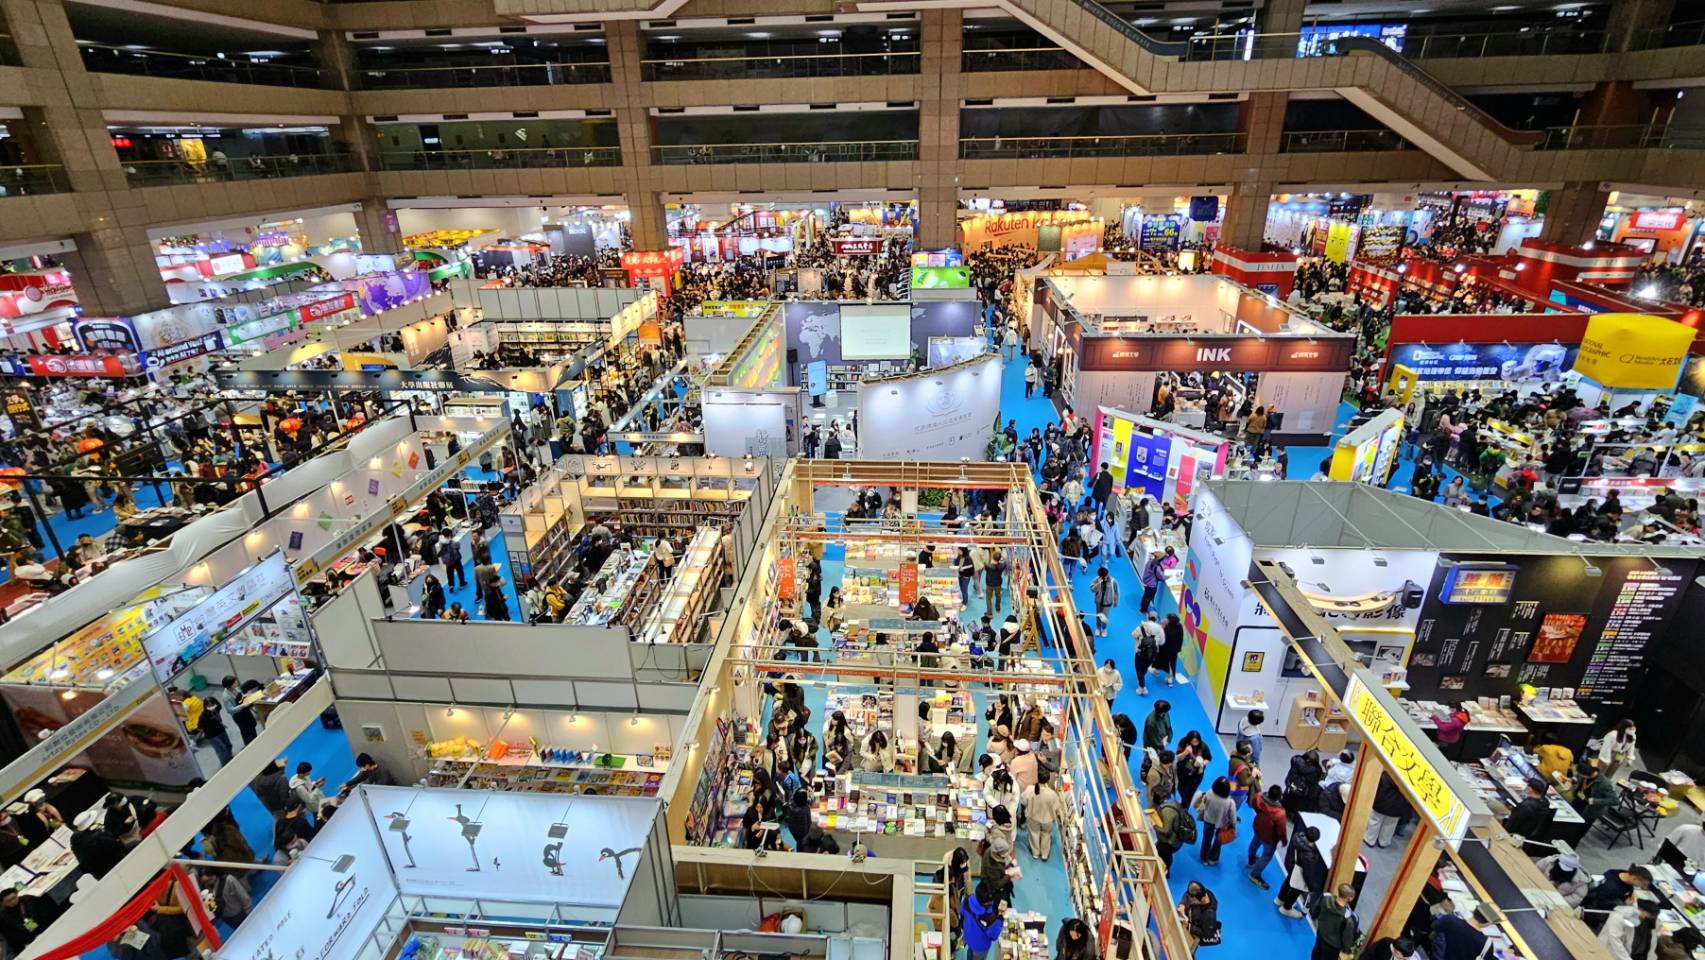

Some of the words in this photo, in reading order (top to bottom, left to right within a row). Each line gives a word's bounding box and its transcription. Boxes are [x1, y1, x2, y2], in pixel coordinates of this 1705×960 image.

[985, 216, 1029, 233] Rakuten
[1196, 348, 1232, 362] INK
[1362, 697, 1442, 809] 聯合文學
